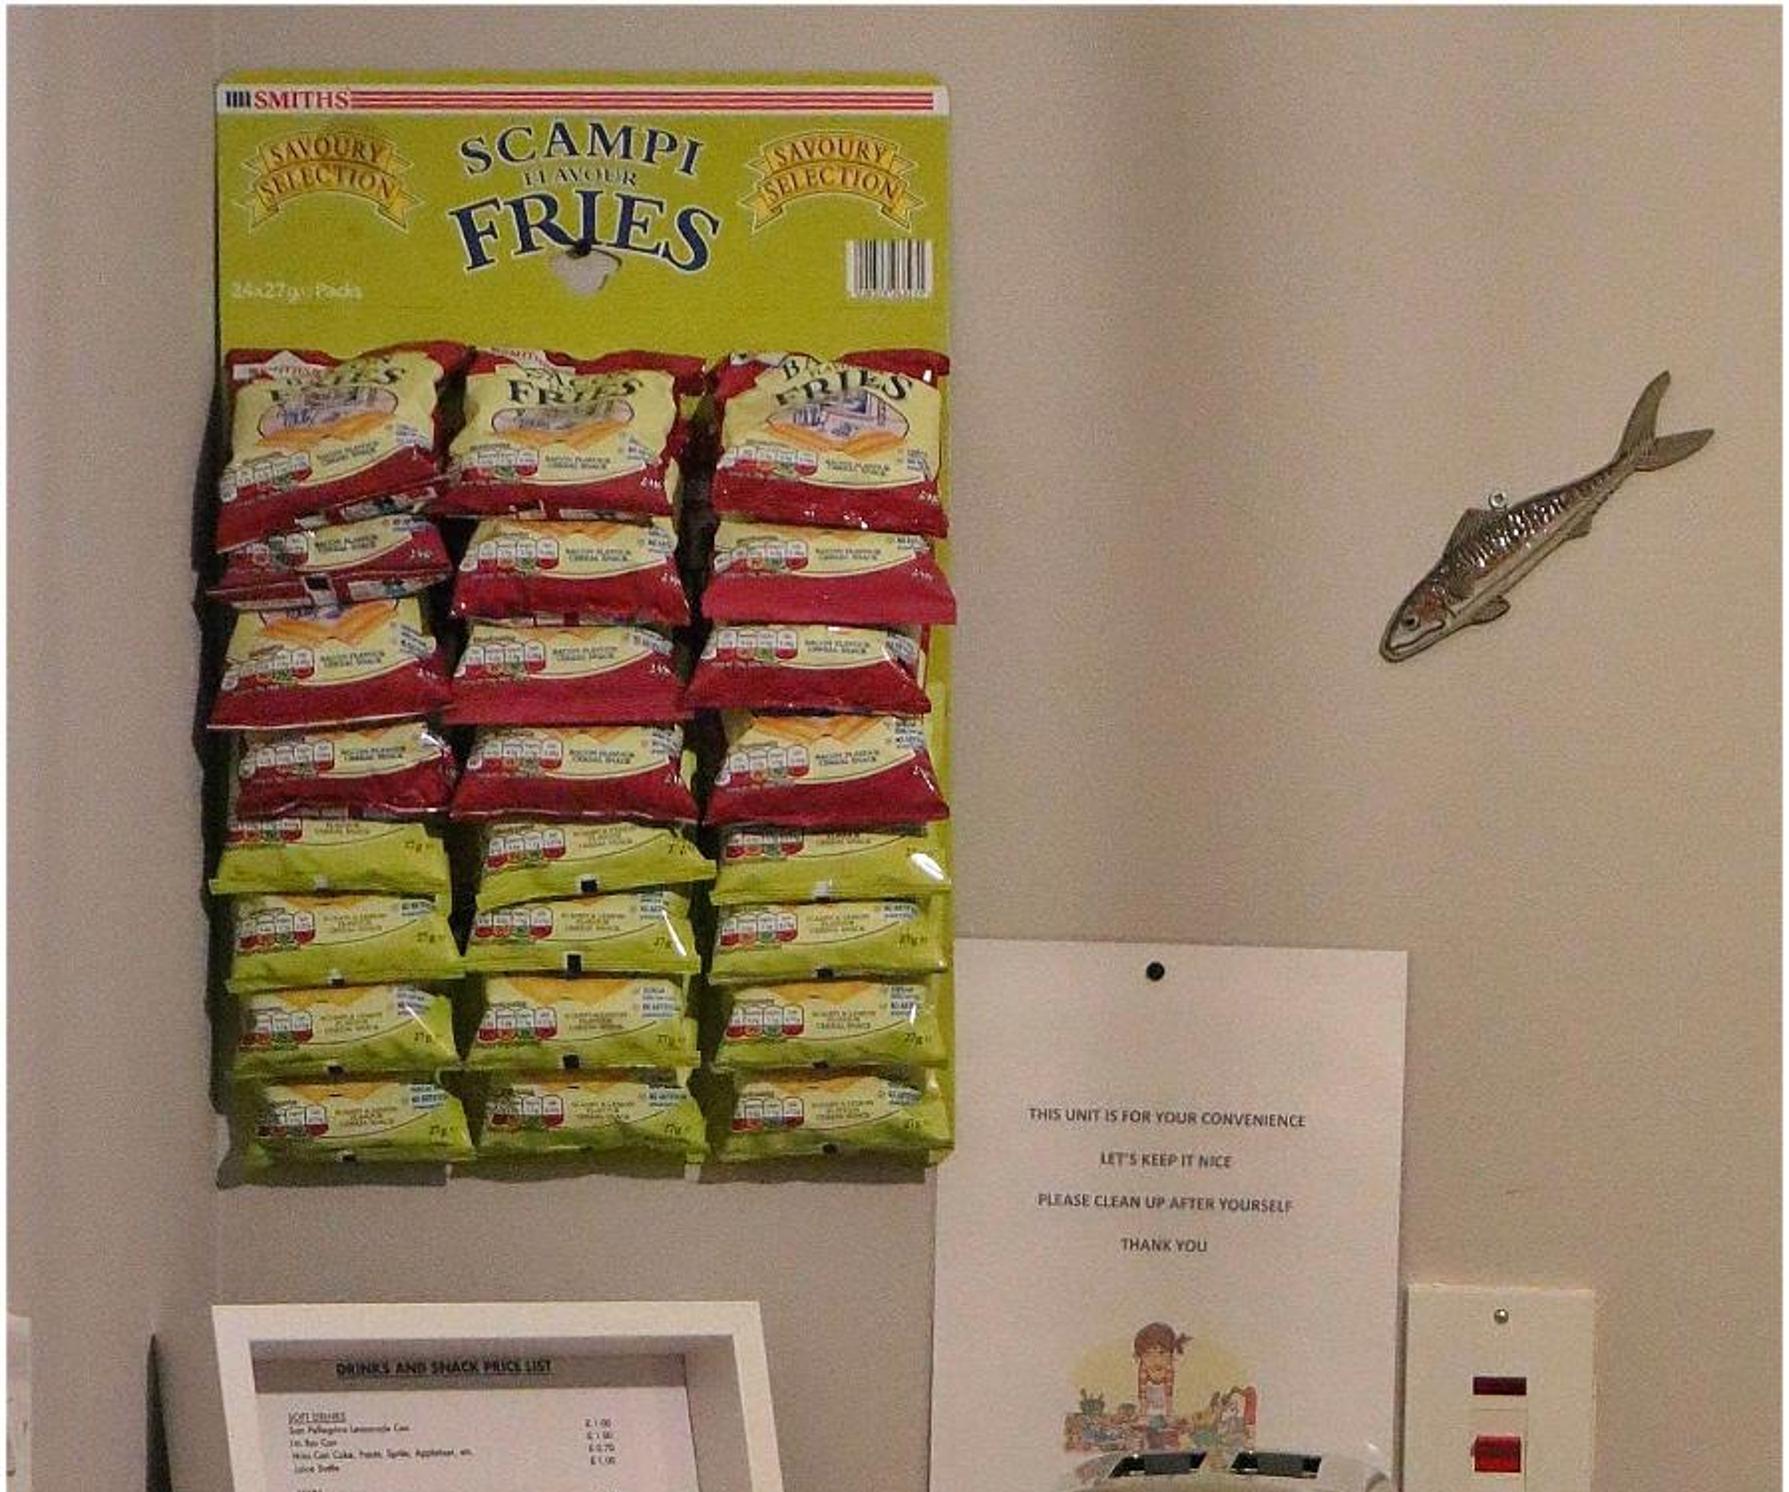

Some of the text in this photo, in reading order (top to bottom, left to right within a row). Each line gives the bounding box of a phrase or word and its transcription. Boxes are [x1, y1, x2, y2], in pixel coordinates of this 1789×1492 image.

[254, 90, 351, 109] SMITHS
[269, 133, 383, 165] SAVOURY
[459, 120, 705, 177] SCAMPI
[773, 136, 886, 167] SAVOURY
[259, 161, 396, 202] SELECTION
[521, 166, 638, 188] FLAVOUR
[764, 164, 903, 202] SELECTION
[448, 189, 721, 272] FRIES
[1029, 1107, 1307, 1129] THIS UNIT IS FOR YOUR CONVENIENCE
[1100, 1150, 1233, 1170] LET'S KEEP IT NICE
[1038, 1192, 1294, 1214] PLEASE CLEAN UP AFTER YOURSELF
[1120, 1236, 1208, 1254] THANK YOU
[335, 1357, 553, 1377] DRINKS AND SNACK PRICE LIST
